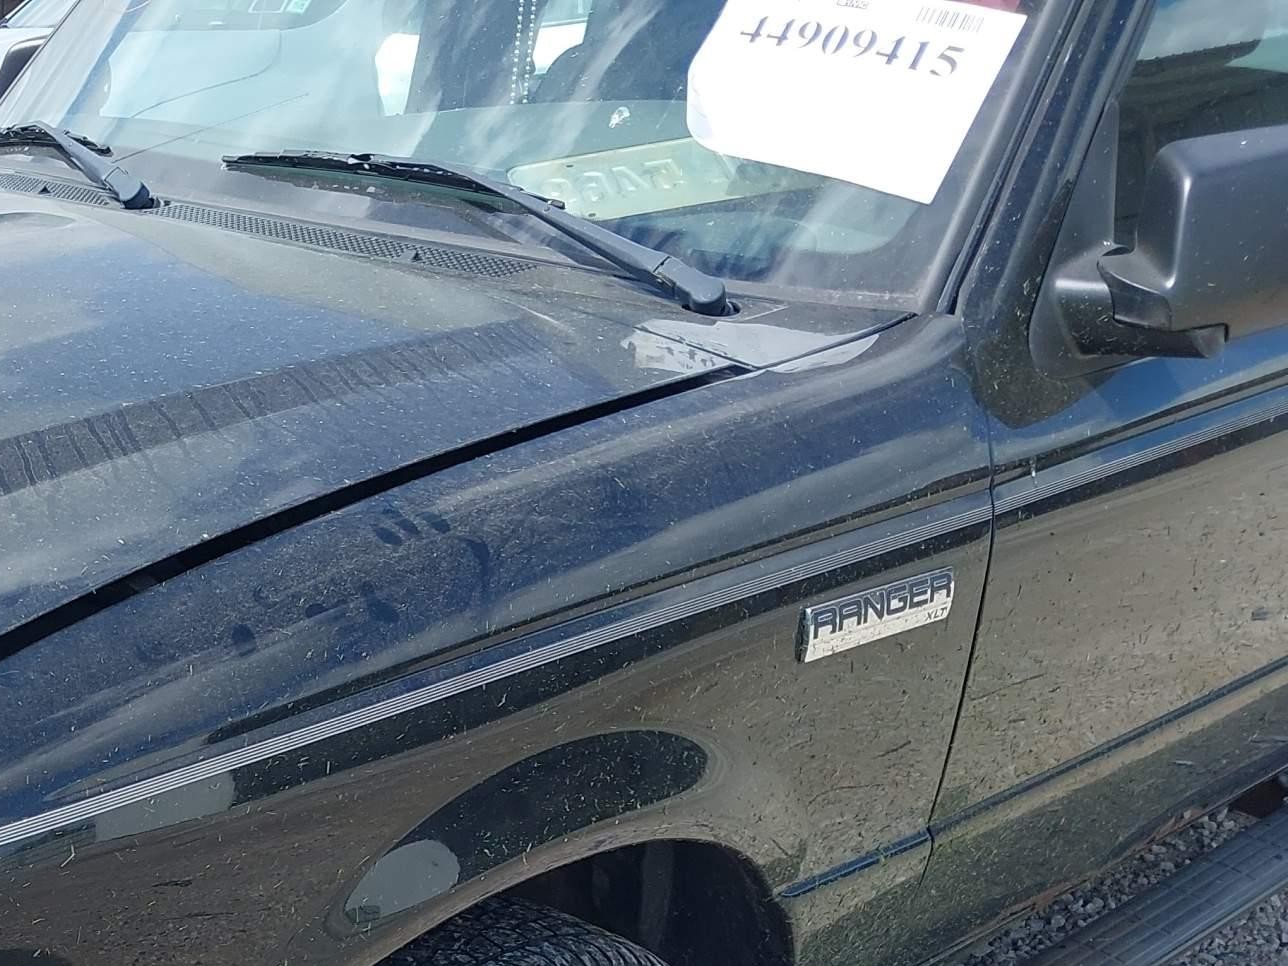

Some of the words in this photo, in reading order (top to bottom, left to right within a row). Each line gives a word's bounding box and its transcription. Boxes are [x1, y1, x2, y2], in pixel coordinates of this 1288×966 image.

[740, 15, 965, 77] 44909415
[812, 571, 953, 640] RANGER
[924, 606, 948, 622] XLT
